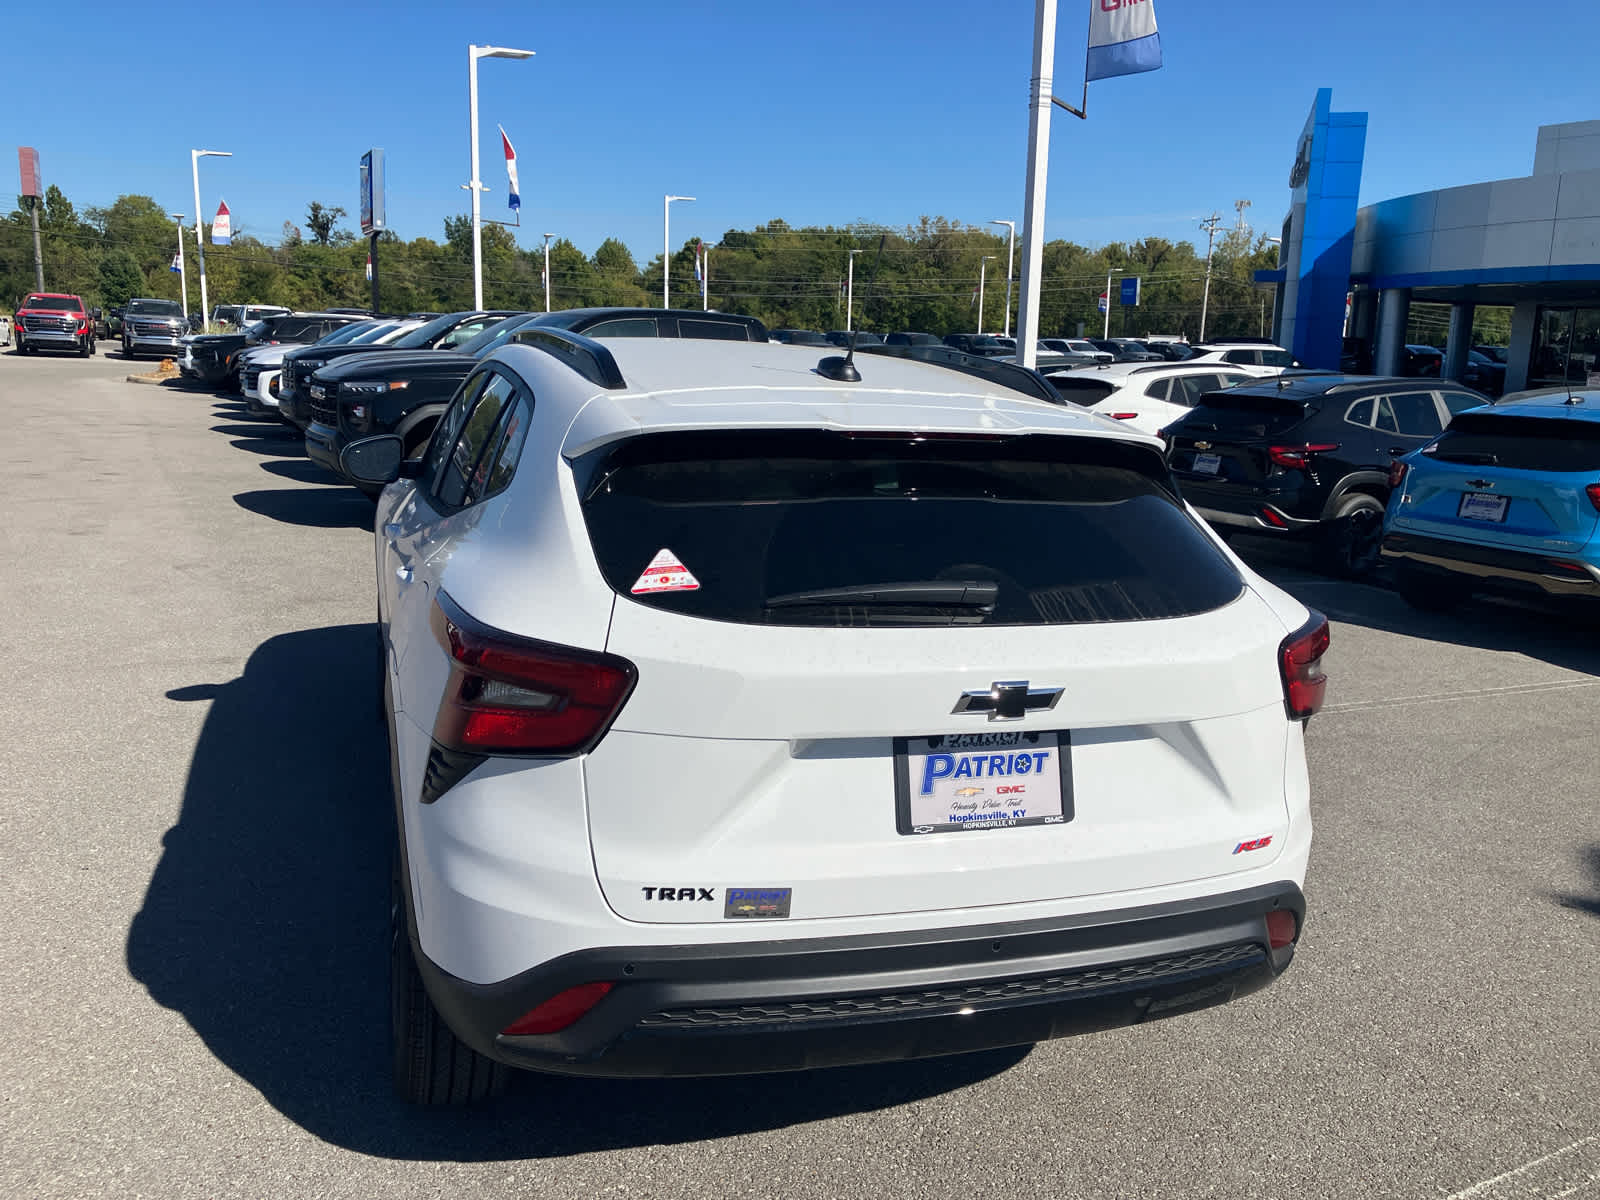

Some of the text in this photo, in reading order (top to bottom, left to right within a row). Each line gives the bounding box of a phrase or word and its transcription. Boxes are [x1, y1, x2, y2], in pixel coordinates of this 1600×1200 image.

[920, 752, 1049, 796] PATRIOT
[996, 785, 1026, 794] GMC
[949, 809, 1026, 823] Hopkinsville, KY
[1044, 816, 1064, 824] GMC
[963, 820, 1008, 829] HOPKINSVILLE,
[642, 887, 715, 901] TRAX
